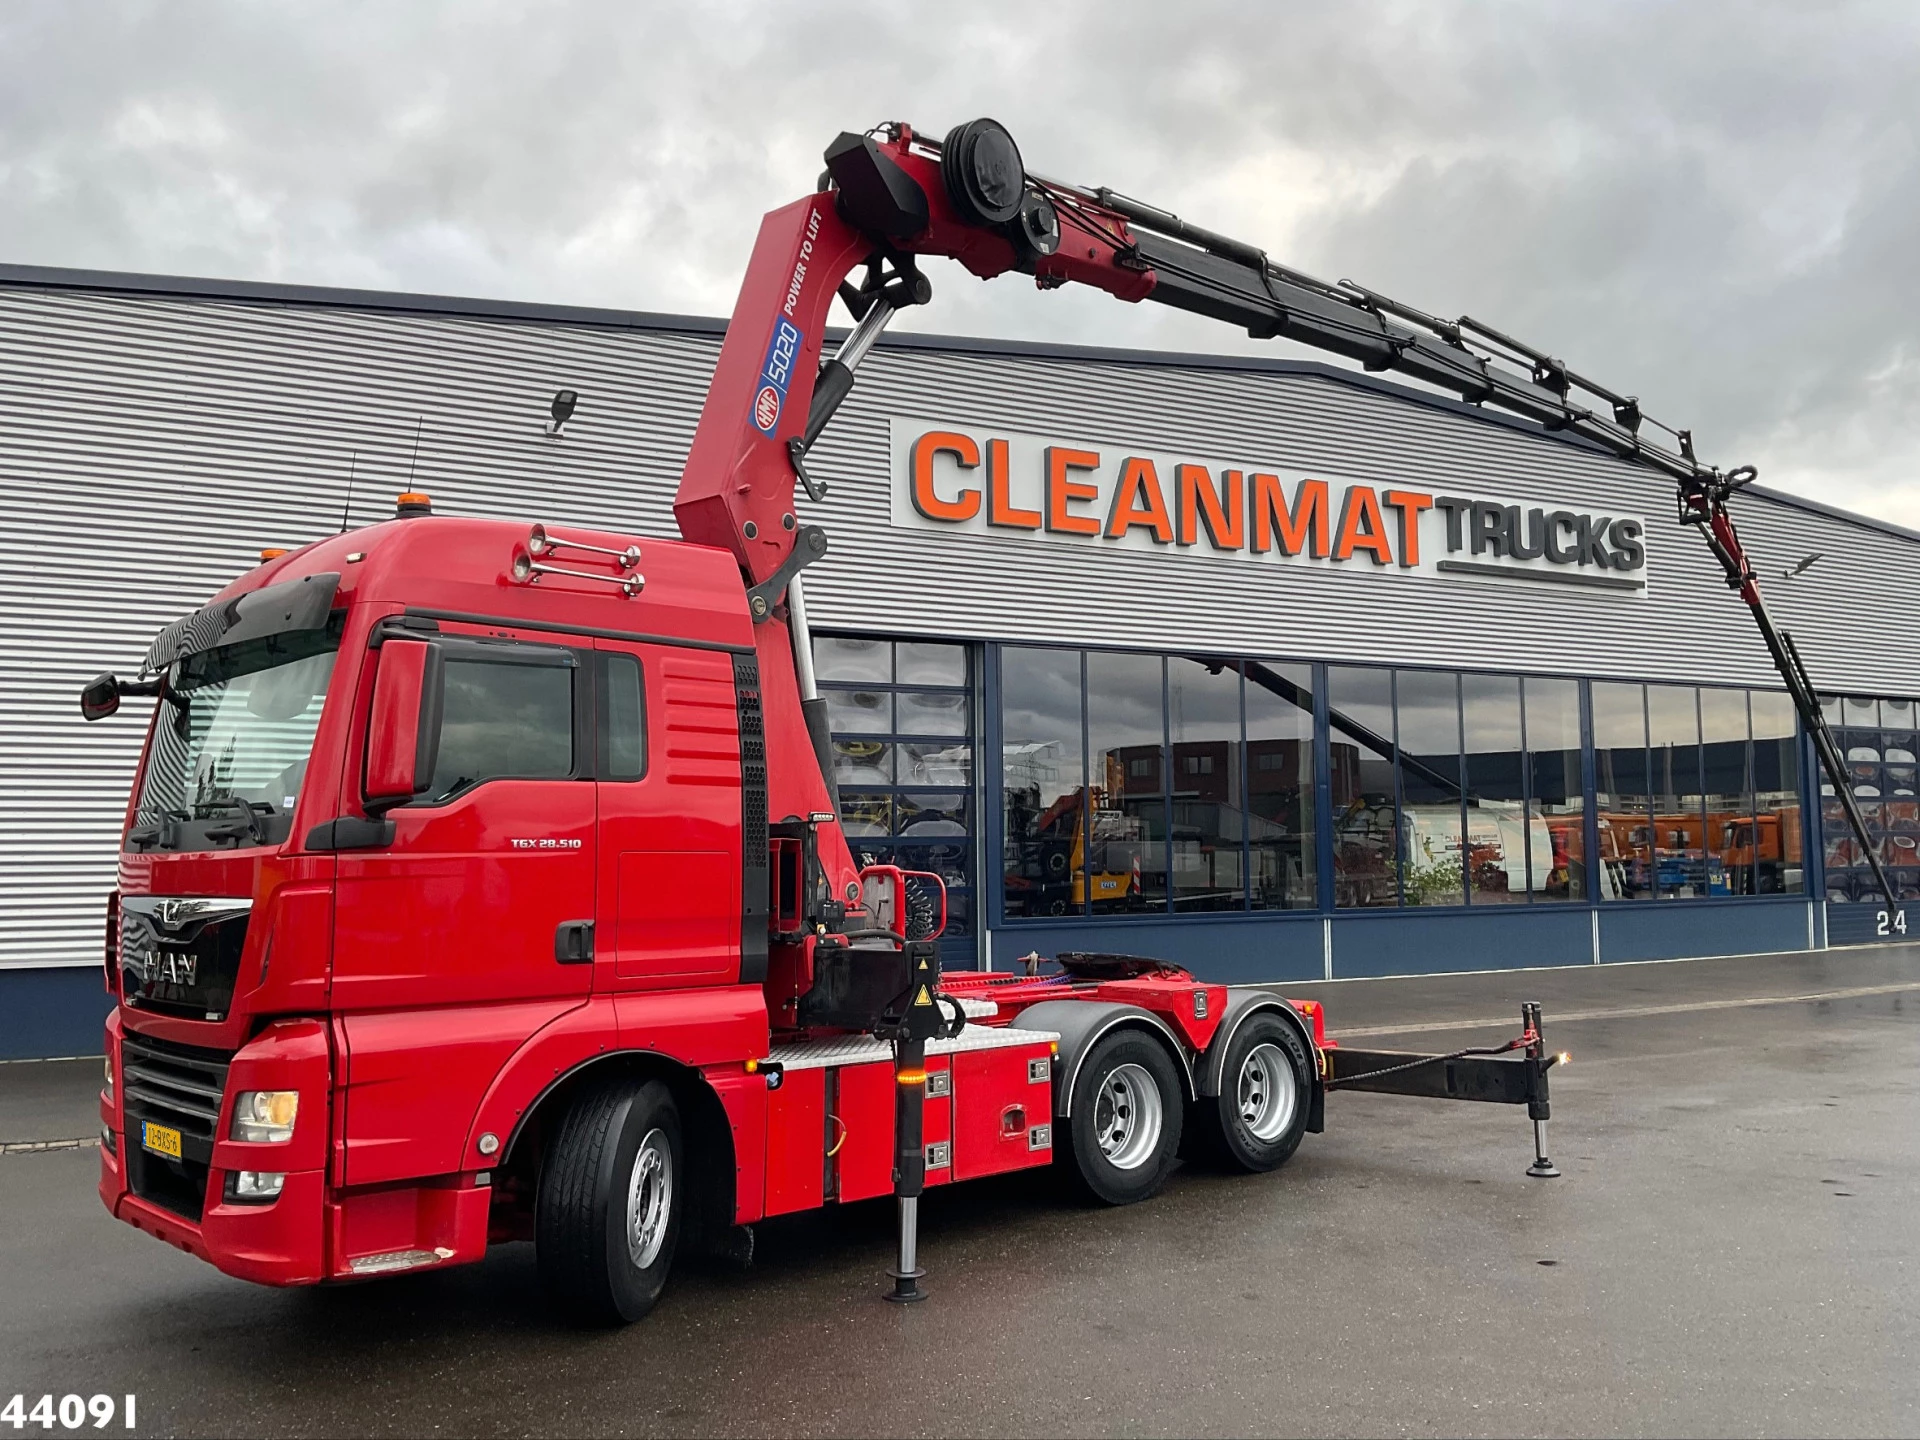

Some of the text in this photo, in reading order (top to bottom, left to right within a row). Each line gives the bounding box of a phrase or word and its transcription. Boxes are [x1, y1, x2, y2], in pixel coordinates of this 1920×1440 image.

[783, 208, 822, 317] POWER TO LIFT
[757, 322, 798, 426] HMF 5020
[909, 430, 1645, 571] CLEANMAT TRUCKS
[511, 839, 582, 849] TGX 28.510
[1877, 910, 1907, 936] 24
[143, 951, 197, 986] MAN
